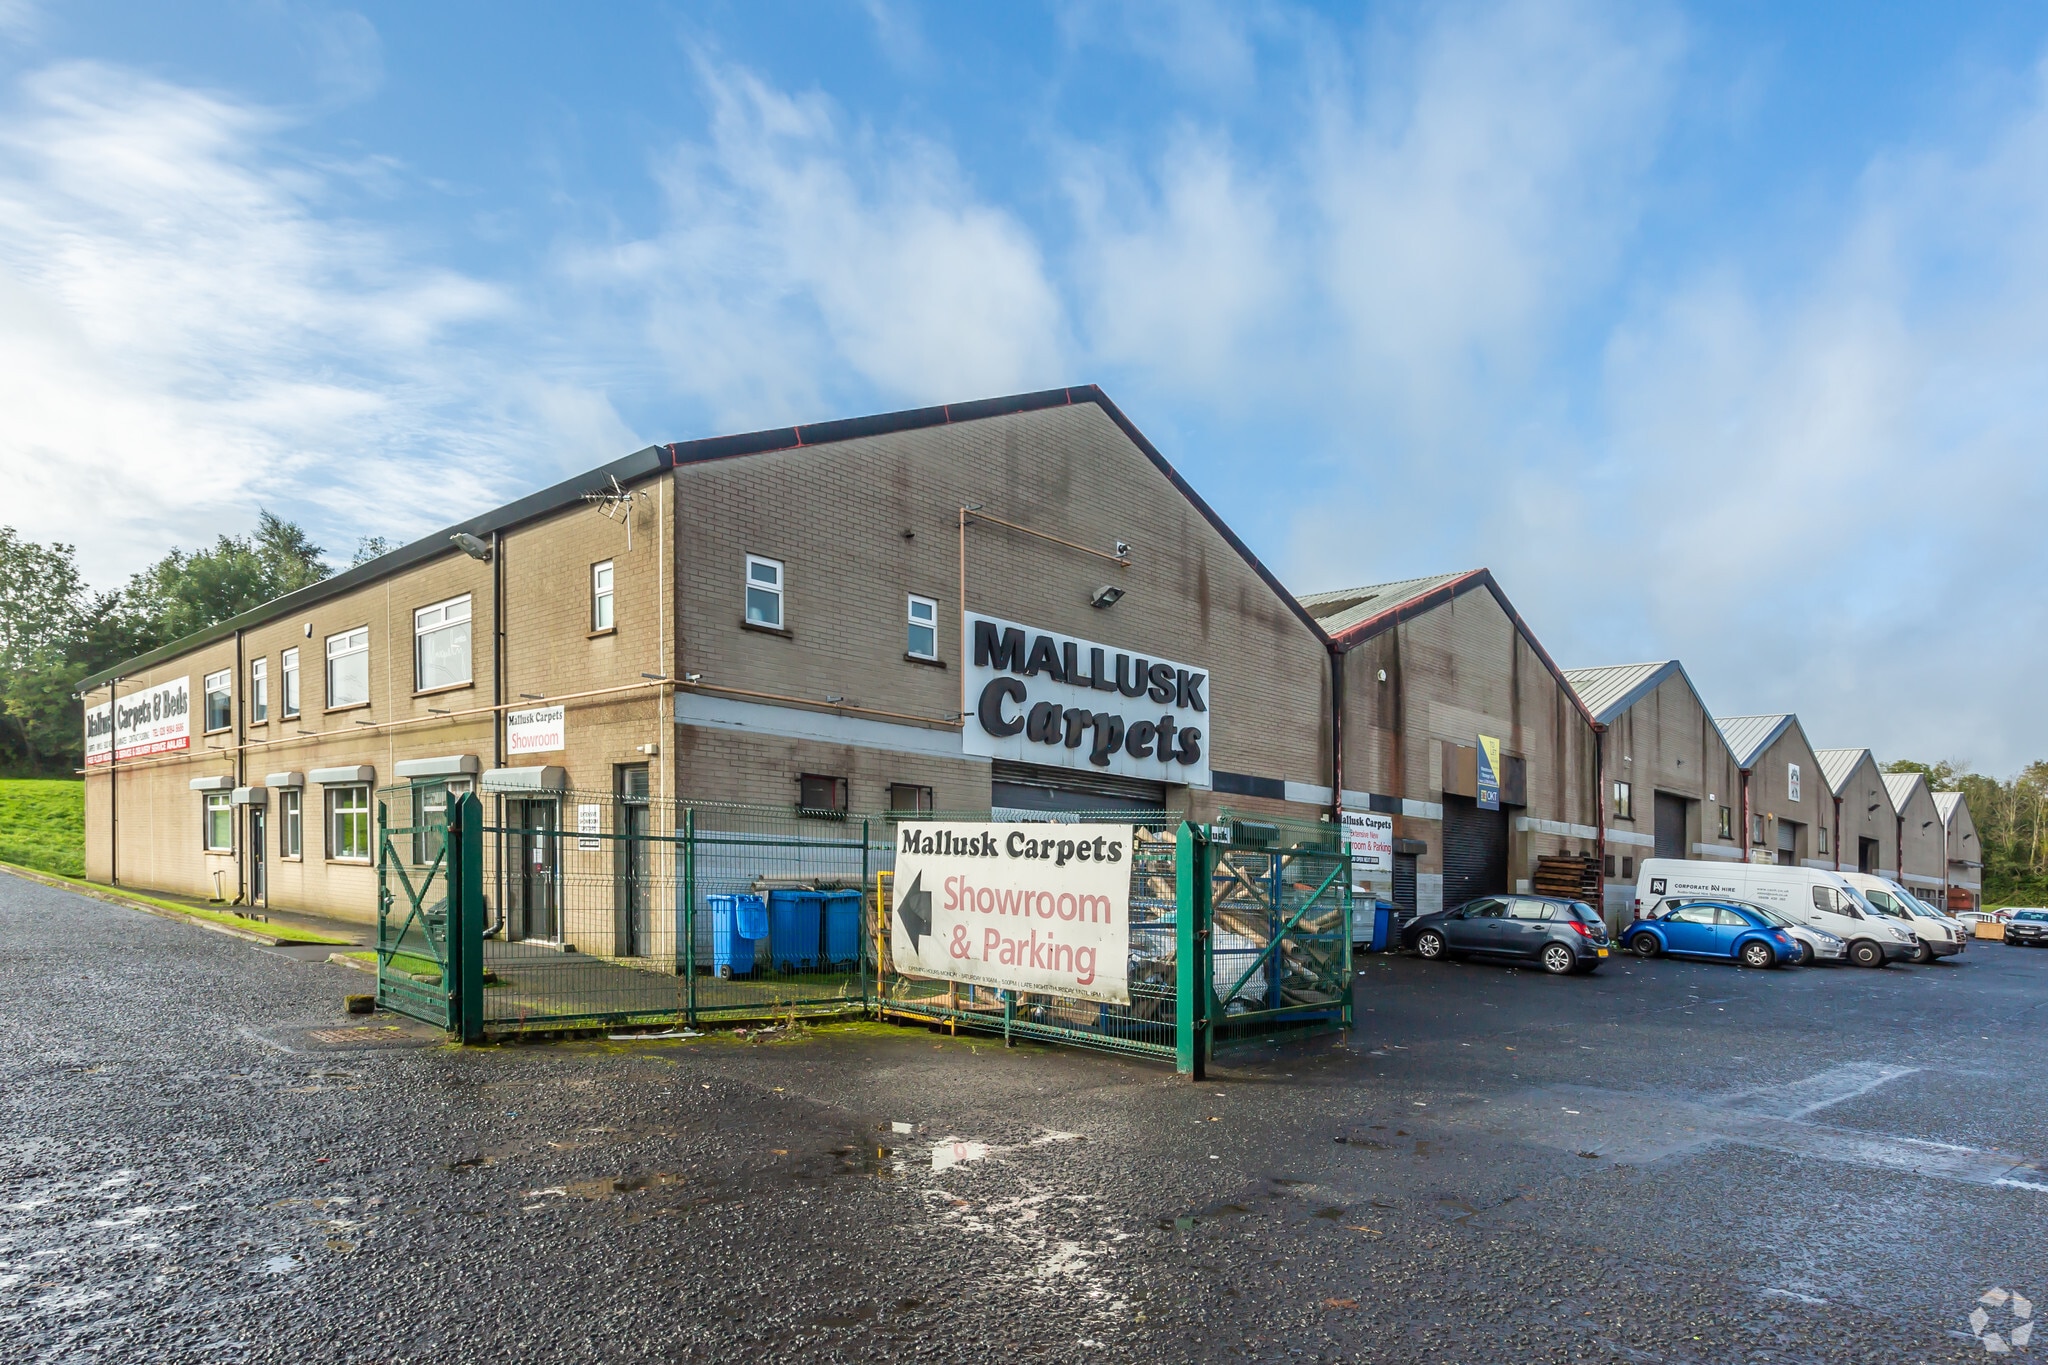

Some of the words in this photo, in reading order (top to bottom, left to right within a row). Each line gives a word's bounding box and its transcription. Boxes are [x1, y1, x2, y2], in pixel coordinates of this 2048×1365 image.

[974, 620, 1207, 712] MALLUSK
[117, 699, 151, 732] Carpets
[153, 693, 161, 721] &
[162, 686, 187, 719] Beds
[508, 713, 534, 726] Mallusk
[535, 710, 563, 723] Carpets
[978, 676, 1201, 766] Carpets
[511, 732, 558, 750] Showroom
[1342, 815, 1364, 826] allusk
[1366, 818, 1391, 830] Carpets
[901, 829, 999, 857] Mallusk
[1006, 831, 1123, 867] Carpets
[1368, 841, 1372, 850] &
[1373, 842, 1392, 855] Parking
[944, 875, 1111, 924] Showroom
[1674, 883, 1709, 891] CORPORATE
[949, 924, 971, 960] &
[982, 927, 1097, 985] Parking
